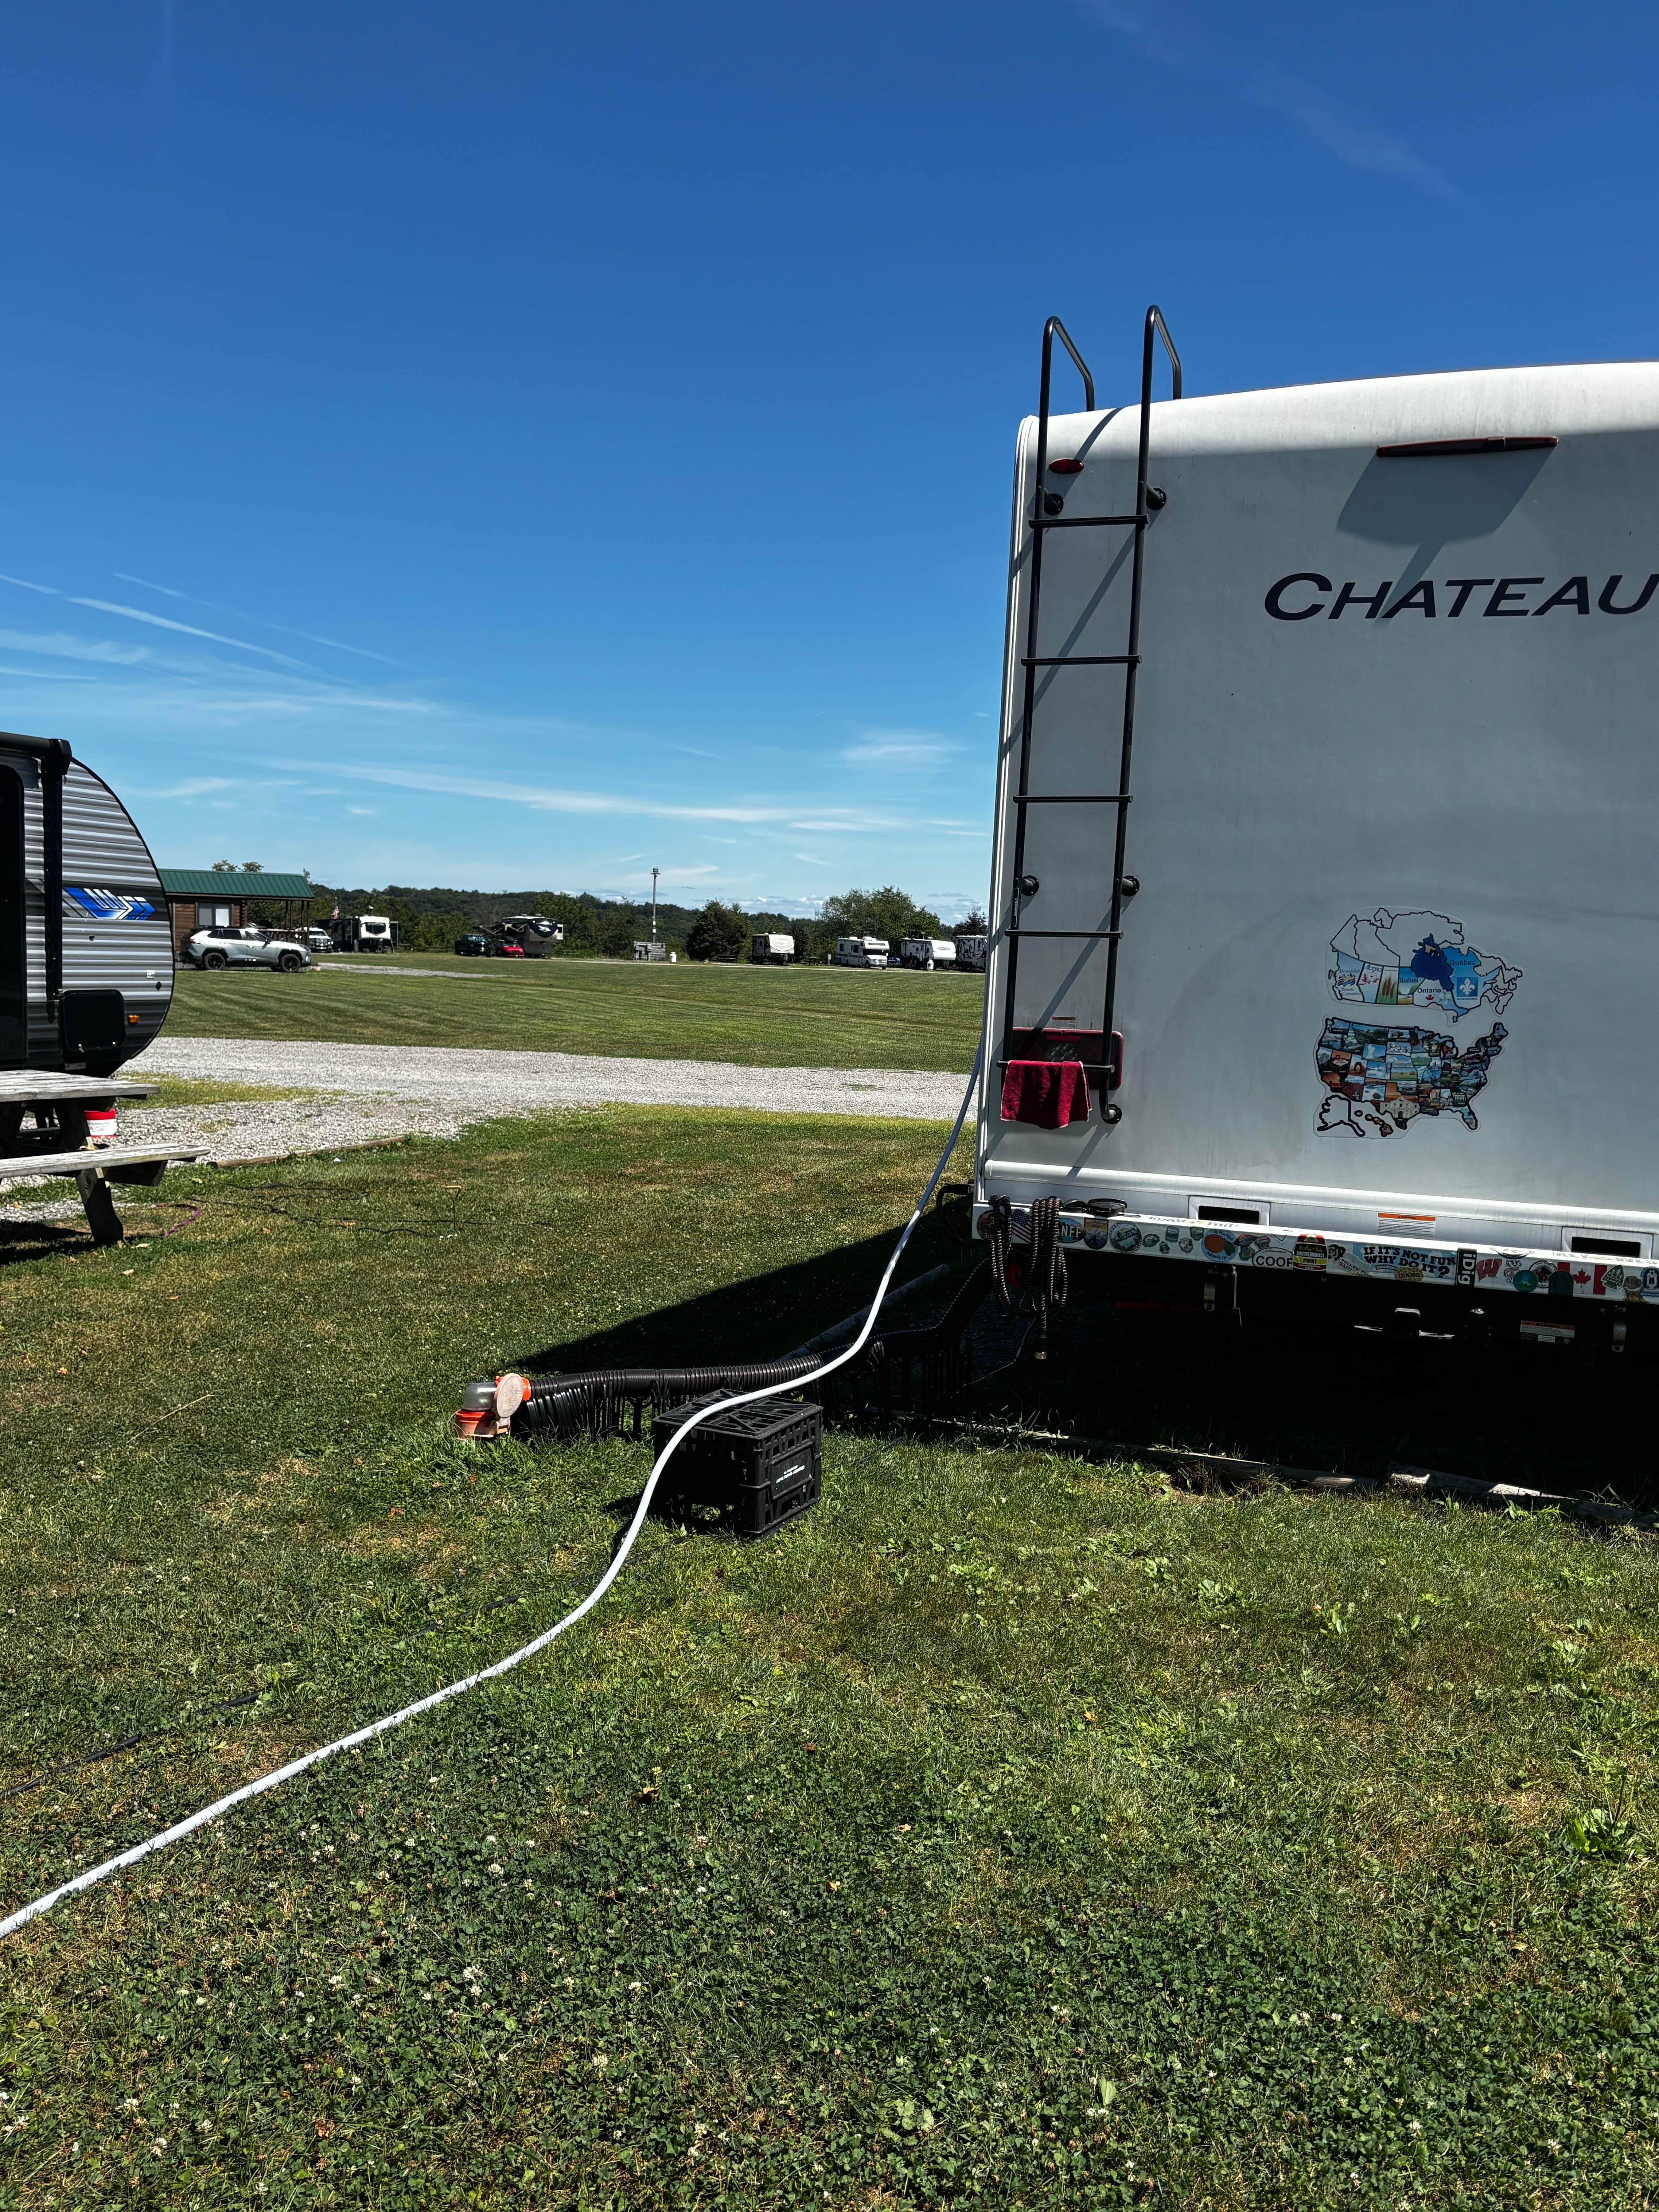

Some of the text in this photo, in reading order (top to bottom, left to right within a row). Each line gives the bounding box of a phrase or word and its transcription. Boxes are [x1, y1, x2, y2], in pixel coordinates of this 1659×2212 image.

[1264, 573, 1659, 620] CHATEAU
[1341, 1259, 1360, 1271] FOLLOW
[1364, 1246, 1456, 1265] IF IT'S NOT FUN
[1364, 1255, 1450, 1278] WHY DO IT?
[1458, 1253, 1476, 1285] iDig
